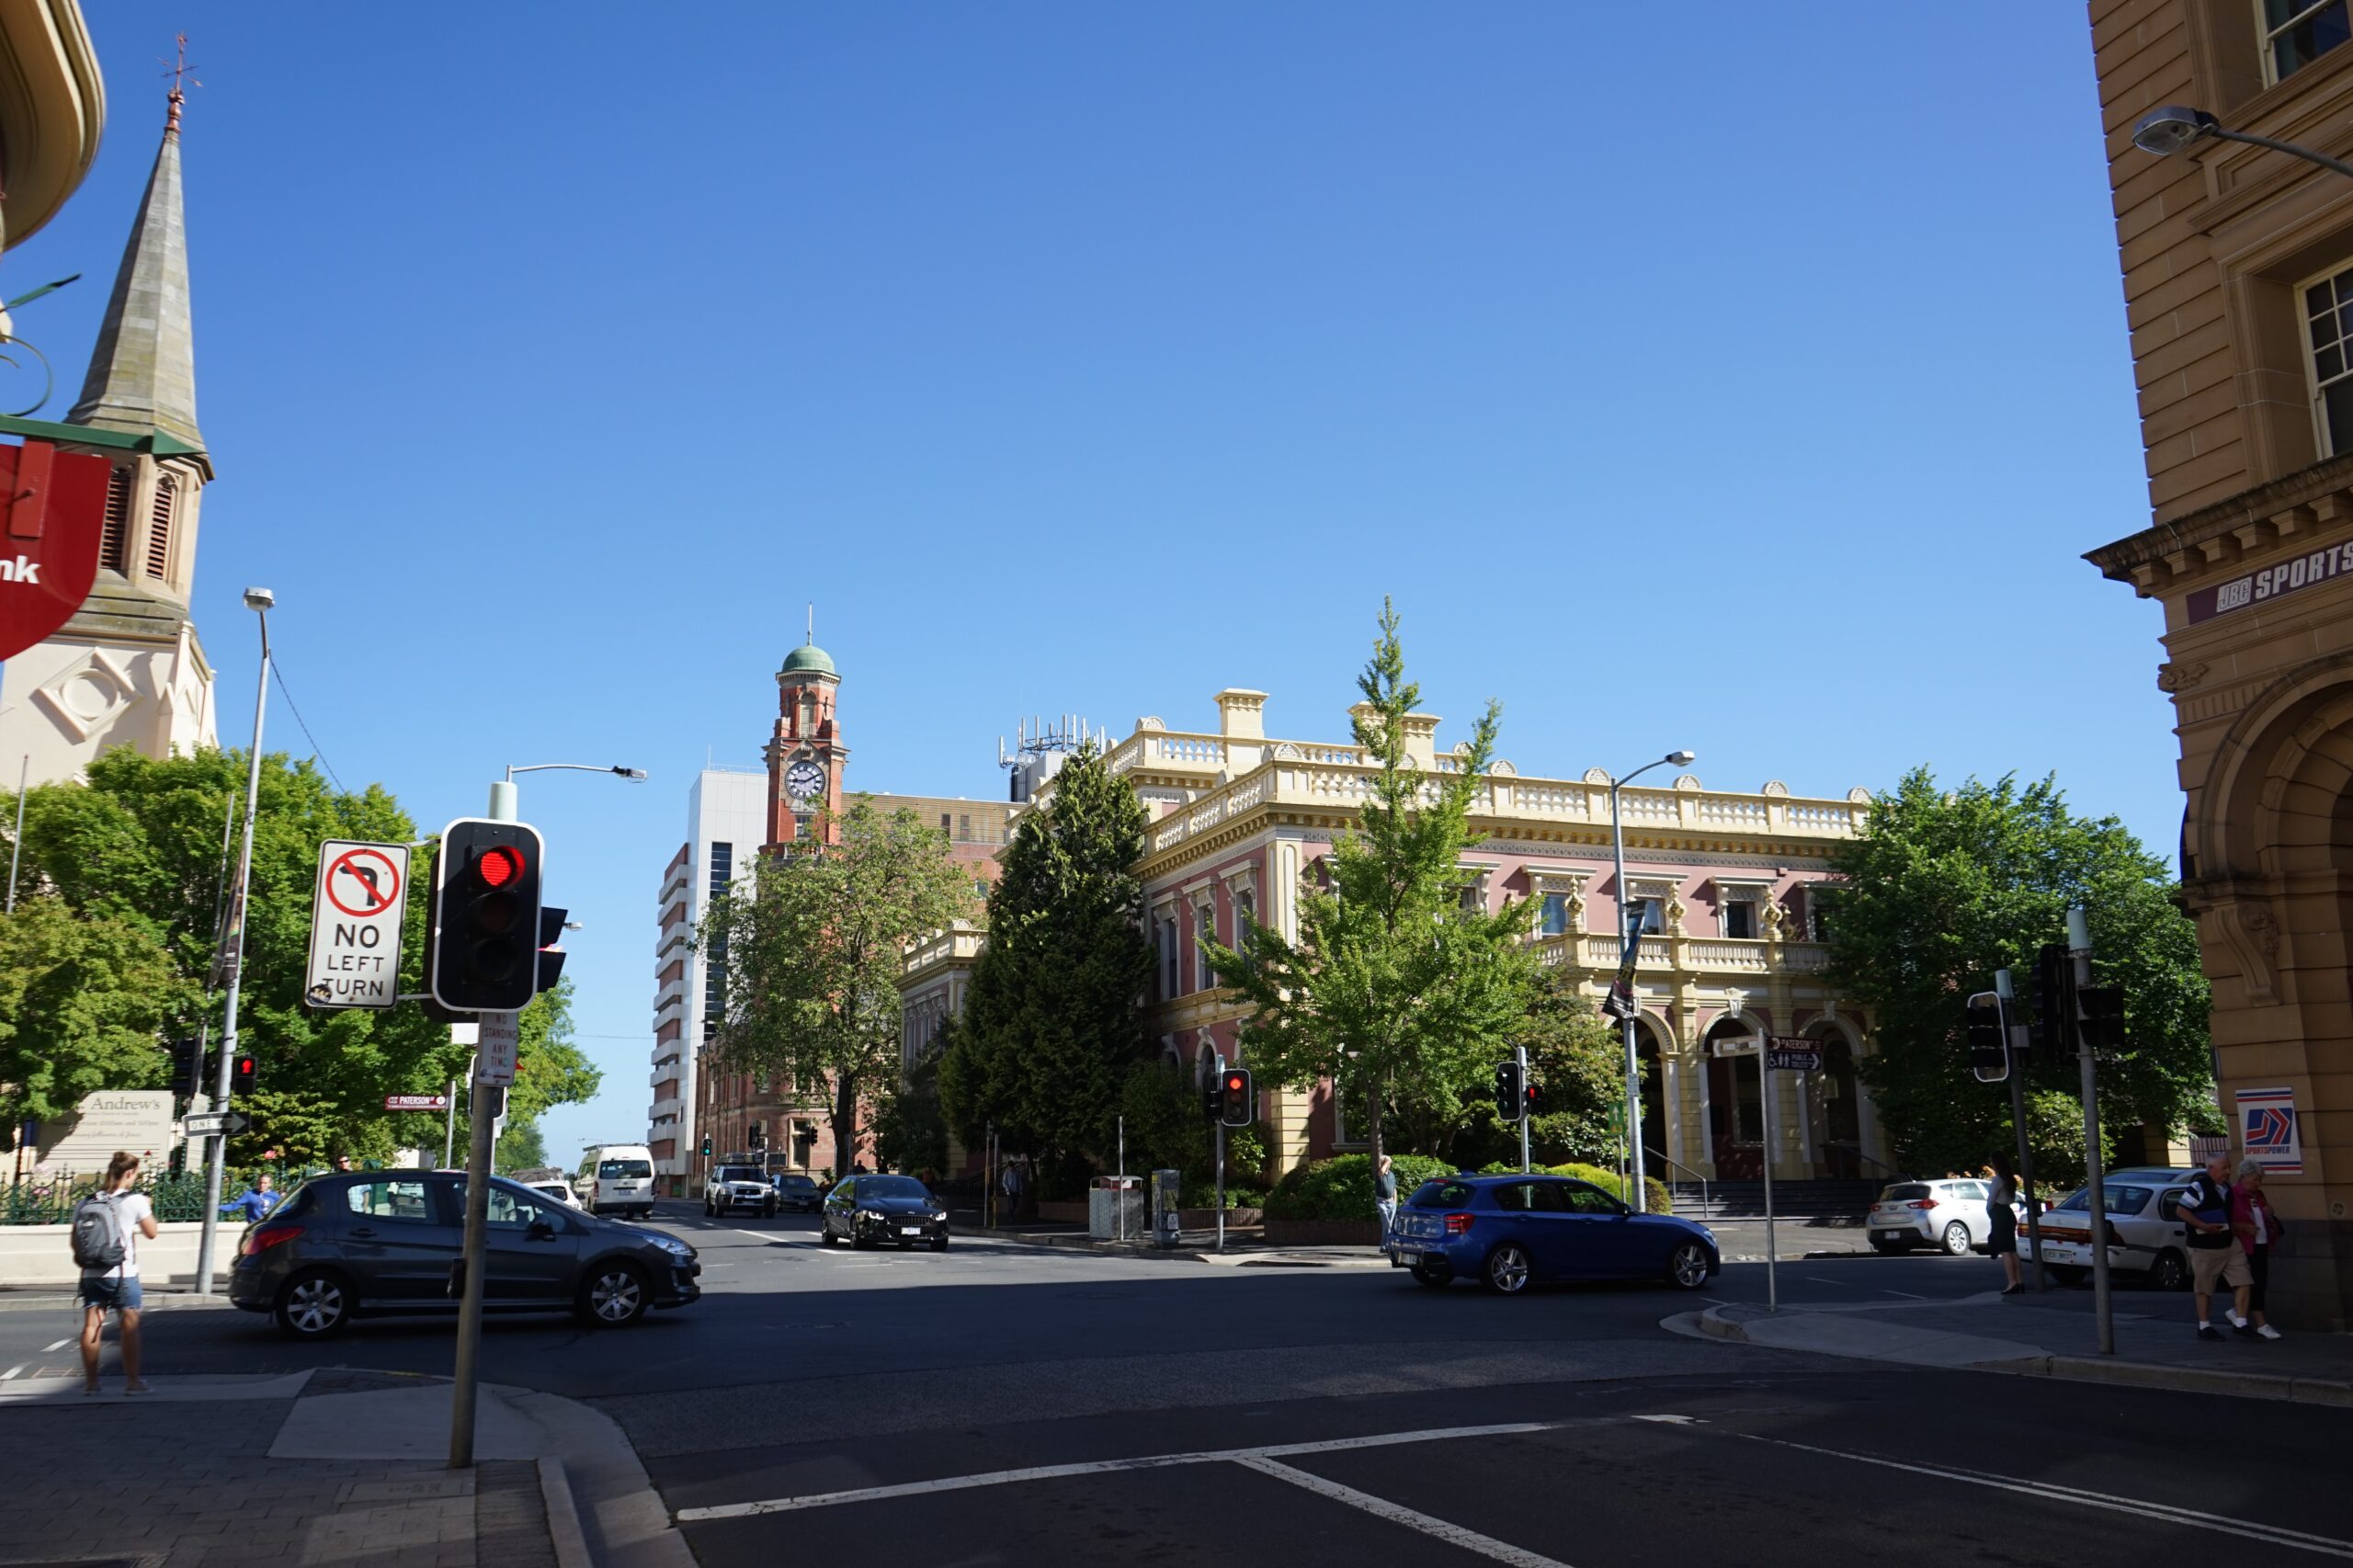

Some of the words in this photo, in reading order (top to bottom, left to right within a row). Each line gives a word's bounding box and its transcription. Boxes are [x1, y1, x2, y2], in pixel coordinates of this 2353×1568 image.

[0, 555, 41, 584] nk
[2218, 580, 2251, 609] JBC
[2255, 541, 2353, 600] SPORTS
[335, 924, 380, 949] NO
[327, 955, 384, 972] LEFT
[322, 978, 383, 996] TURN
[495, 1015, 507, 1025] NO
[484, 1028, 517, 1040] STANDING
[492, 1044, 508, 1054] ANY
[91, 1096, 161, 1110] Andrew's
[400, 1096, 430, 1105] PATERSON
[191, 1119, 212, 1130] ONE
[2245, 1146, 2290, 1154] SPORTSPOWER
